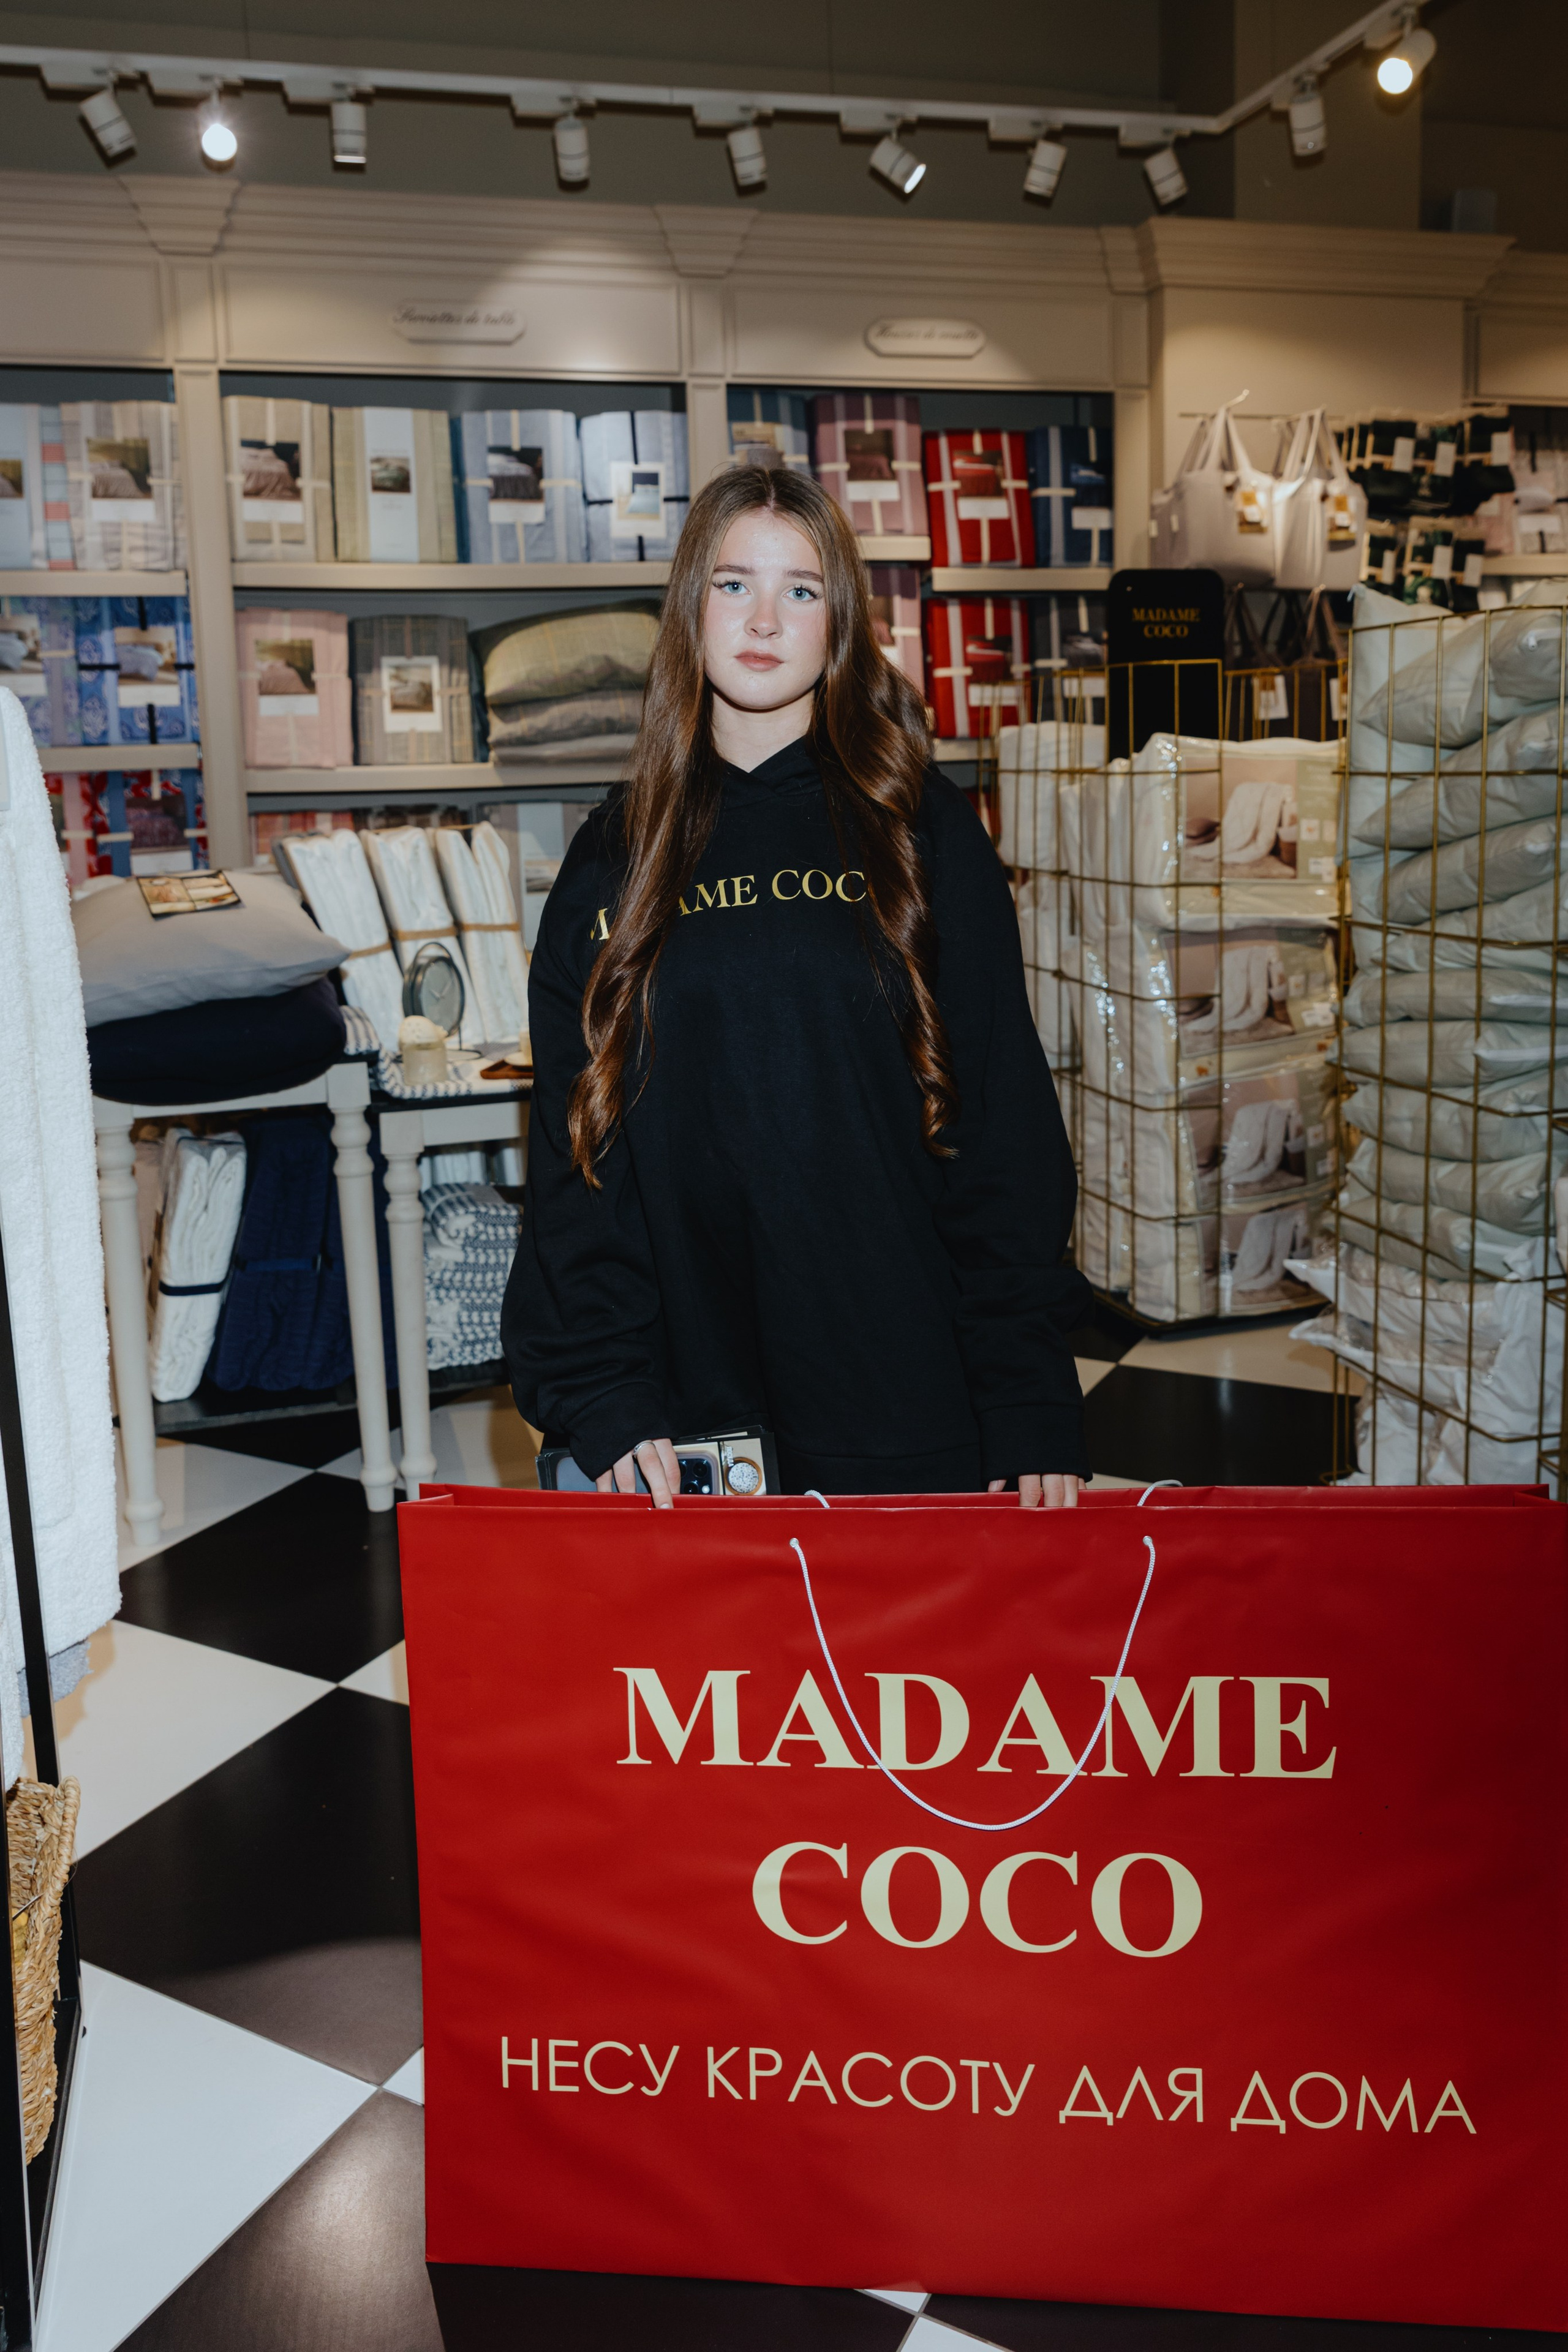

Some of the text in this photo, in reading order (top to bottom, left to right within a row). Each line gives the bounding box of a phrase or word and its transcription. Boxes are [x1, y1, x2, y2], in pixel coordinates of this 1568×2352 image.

[1133, 608, 1200, 622] MADAME
[1144, 624, 1189, 638] COCO
[772, 869, 867, 902] COC
[613, 1667, 1337, 1779] MADAME
[752, 1841, 1203, 1958] COCO
[501, 2036, 1477, 2134] НЕСУ КРАСОТУ ДЛЯ ДОМА
